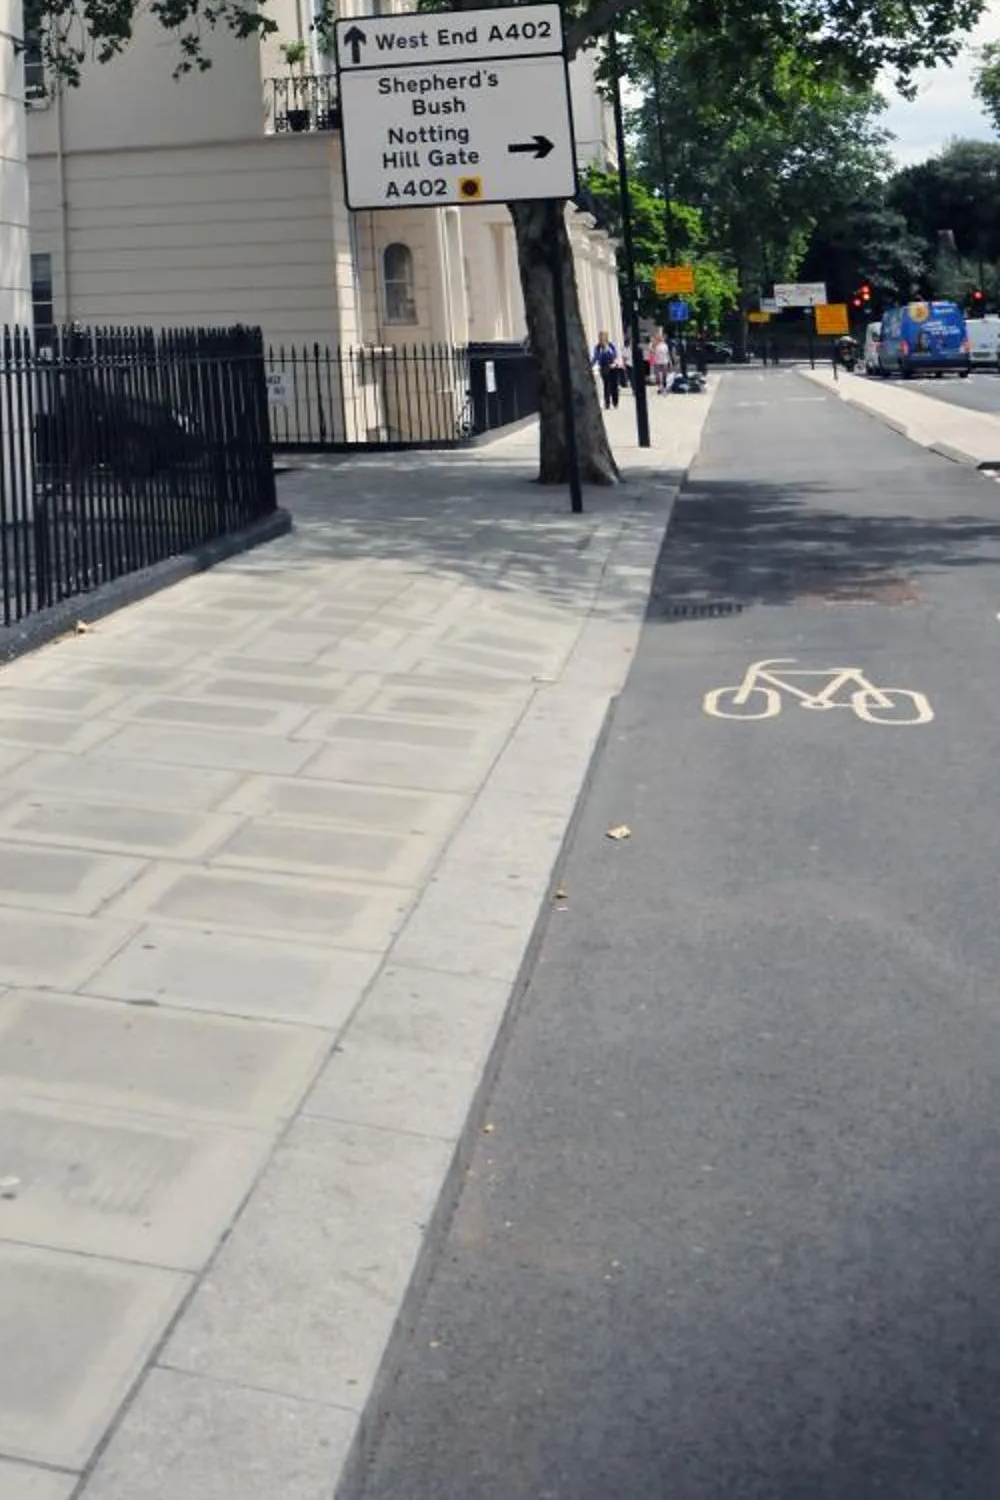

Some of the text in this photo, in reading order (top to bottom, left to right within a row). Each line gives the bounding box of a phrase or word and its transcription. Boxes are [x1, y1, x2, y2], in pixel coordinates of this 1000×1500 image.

[375, 21, 552, 51] West End A402
[378, 69, 499, 95] Shepherd's
[411, 96, 466, 116] Bush
[387, 124, 470, 145] Notting
[382, 147, 480, 169] Hill Gate
[385, 178, 448, 198] A402
